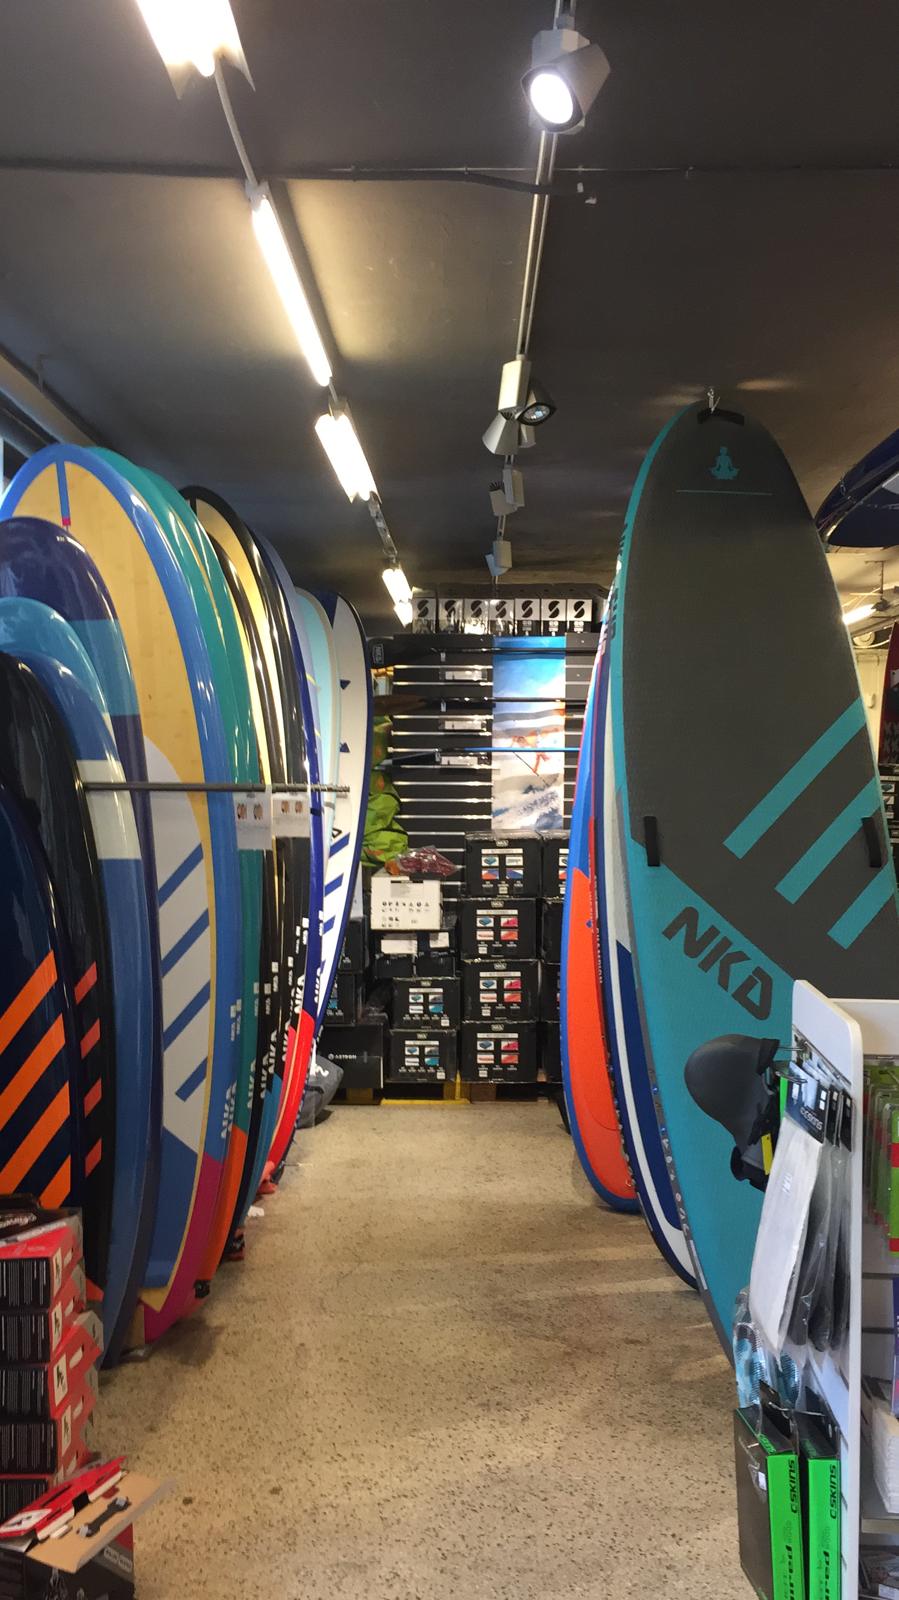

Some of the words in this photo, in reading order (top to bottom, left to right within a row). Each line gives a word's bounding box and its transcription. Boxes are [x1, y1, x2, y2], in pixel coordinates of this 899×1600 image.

[662, 906, 773, 1020] NKD
[788, 1460, 798, 1514] CSKINS
[829, 1464, 837, 1520] CSKINS
